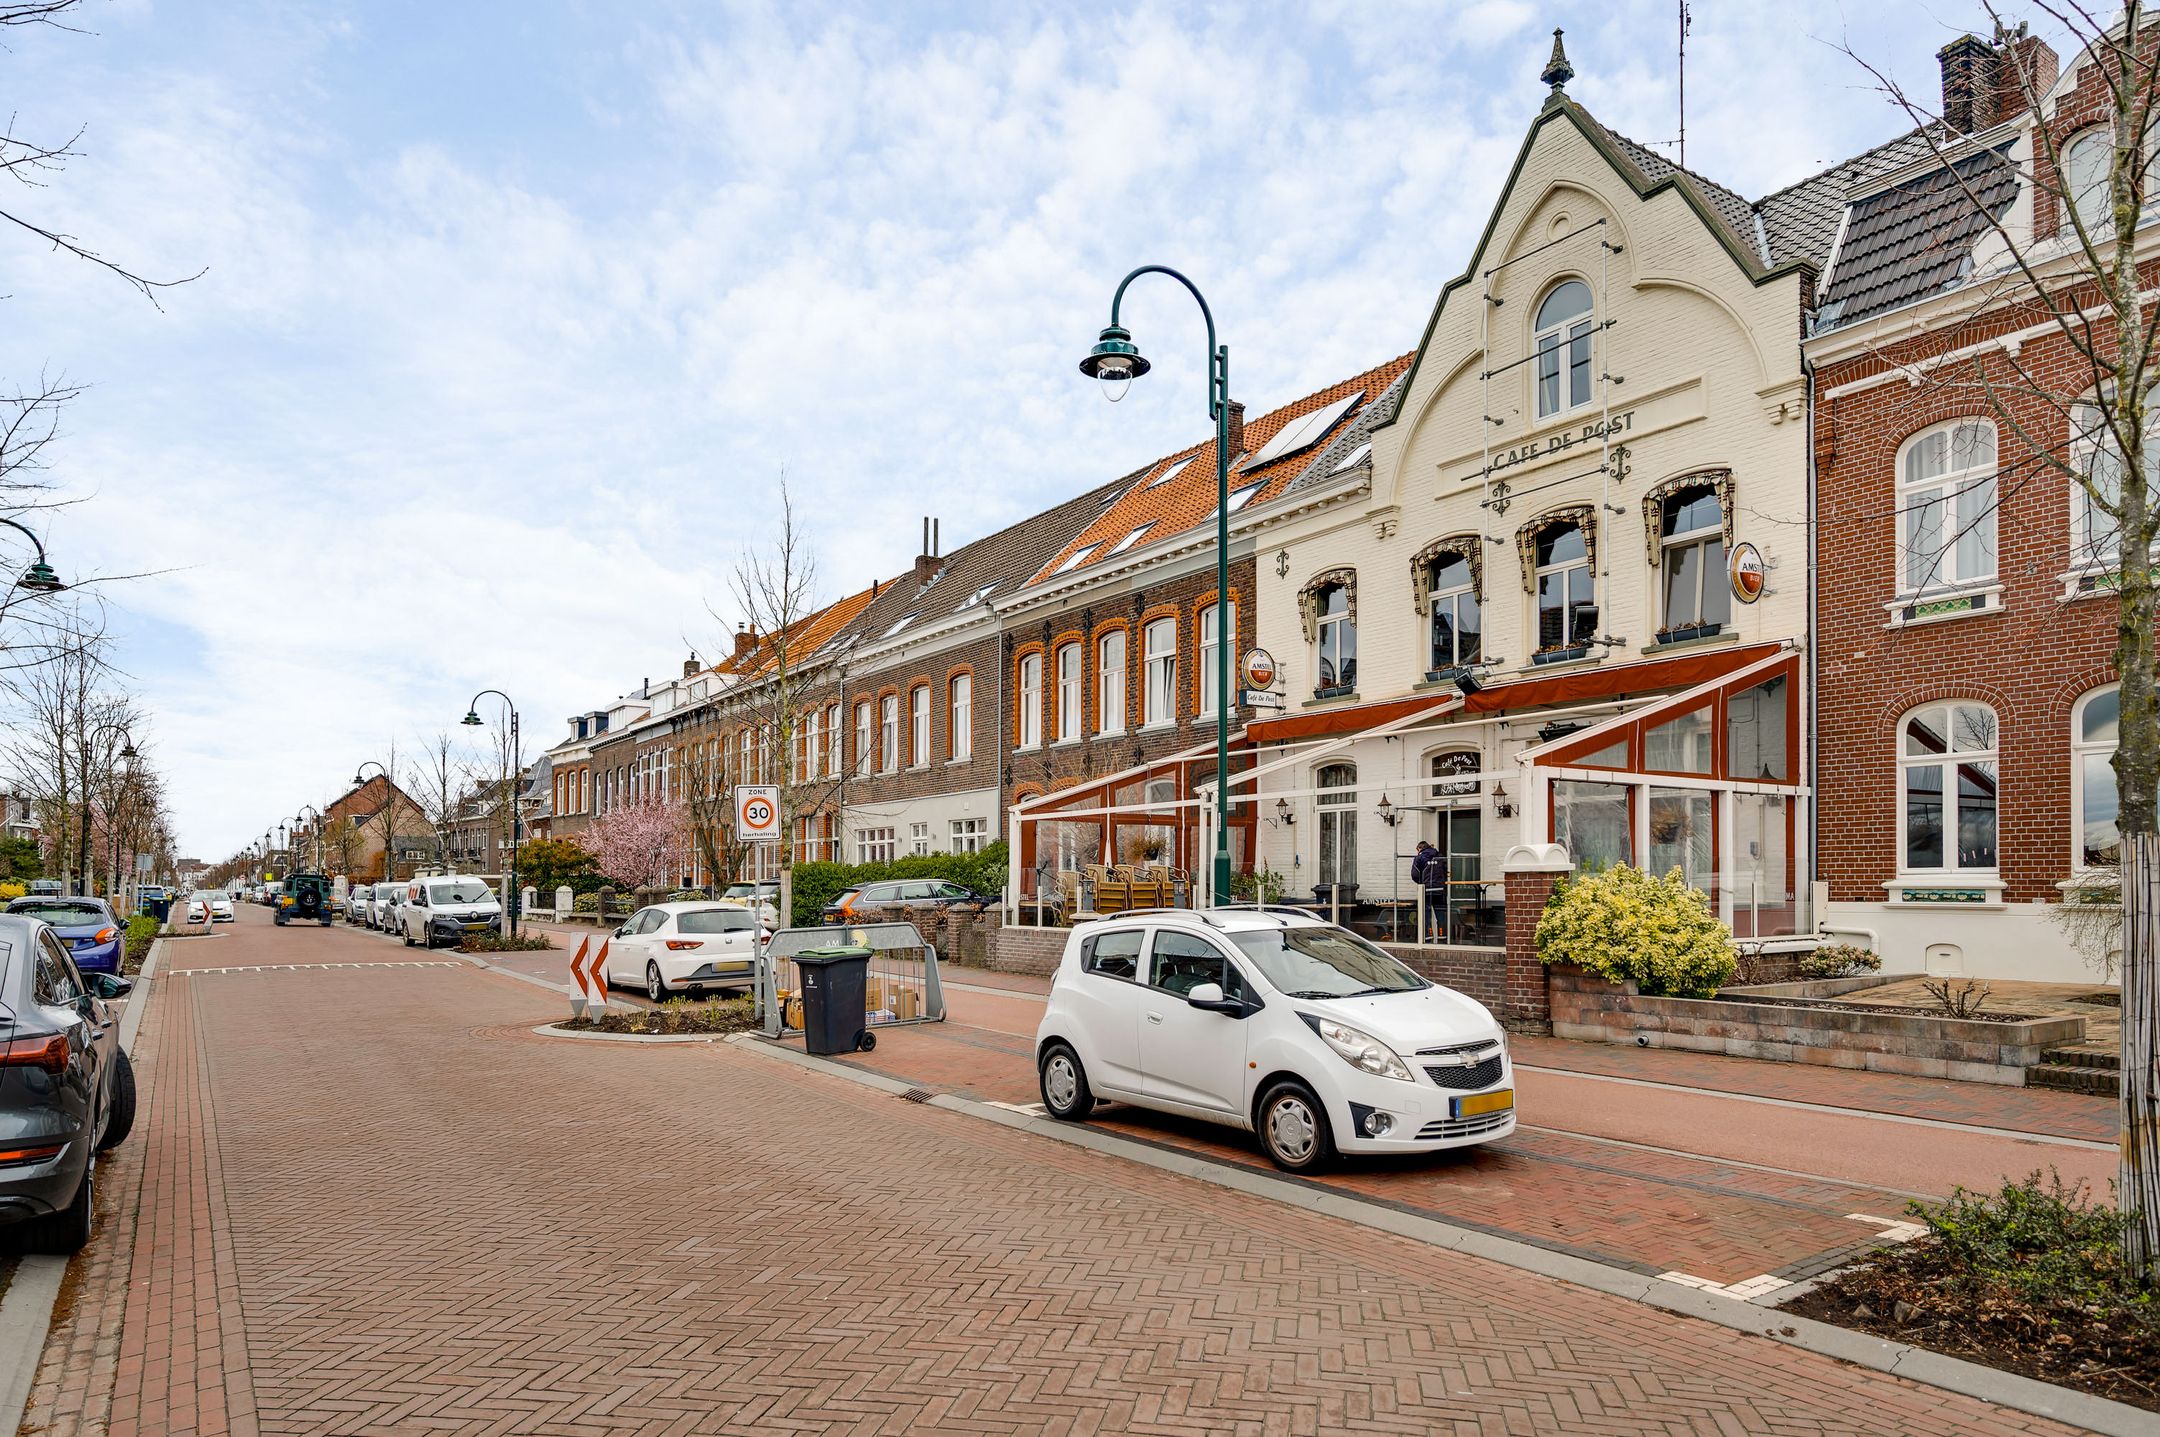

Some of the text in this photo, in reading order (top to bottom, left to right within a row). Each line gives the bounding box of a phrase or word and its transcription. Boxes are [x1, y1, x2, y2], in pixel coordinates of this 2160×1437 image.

[1493, 411, 1635, 470] CAFE DE POST
[749, 807, 769, 819] 30
